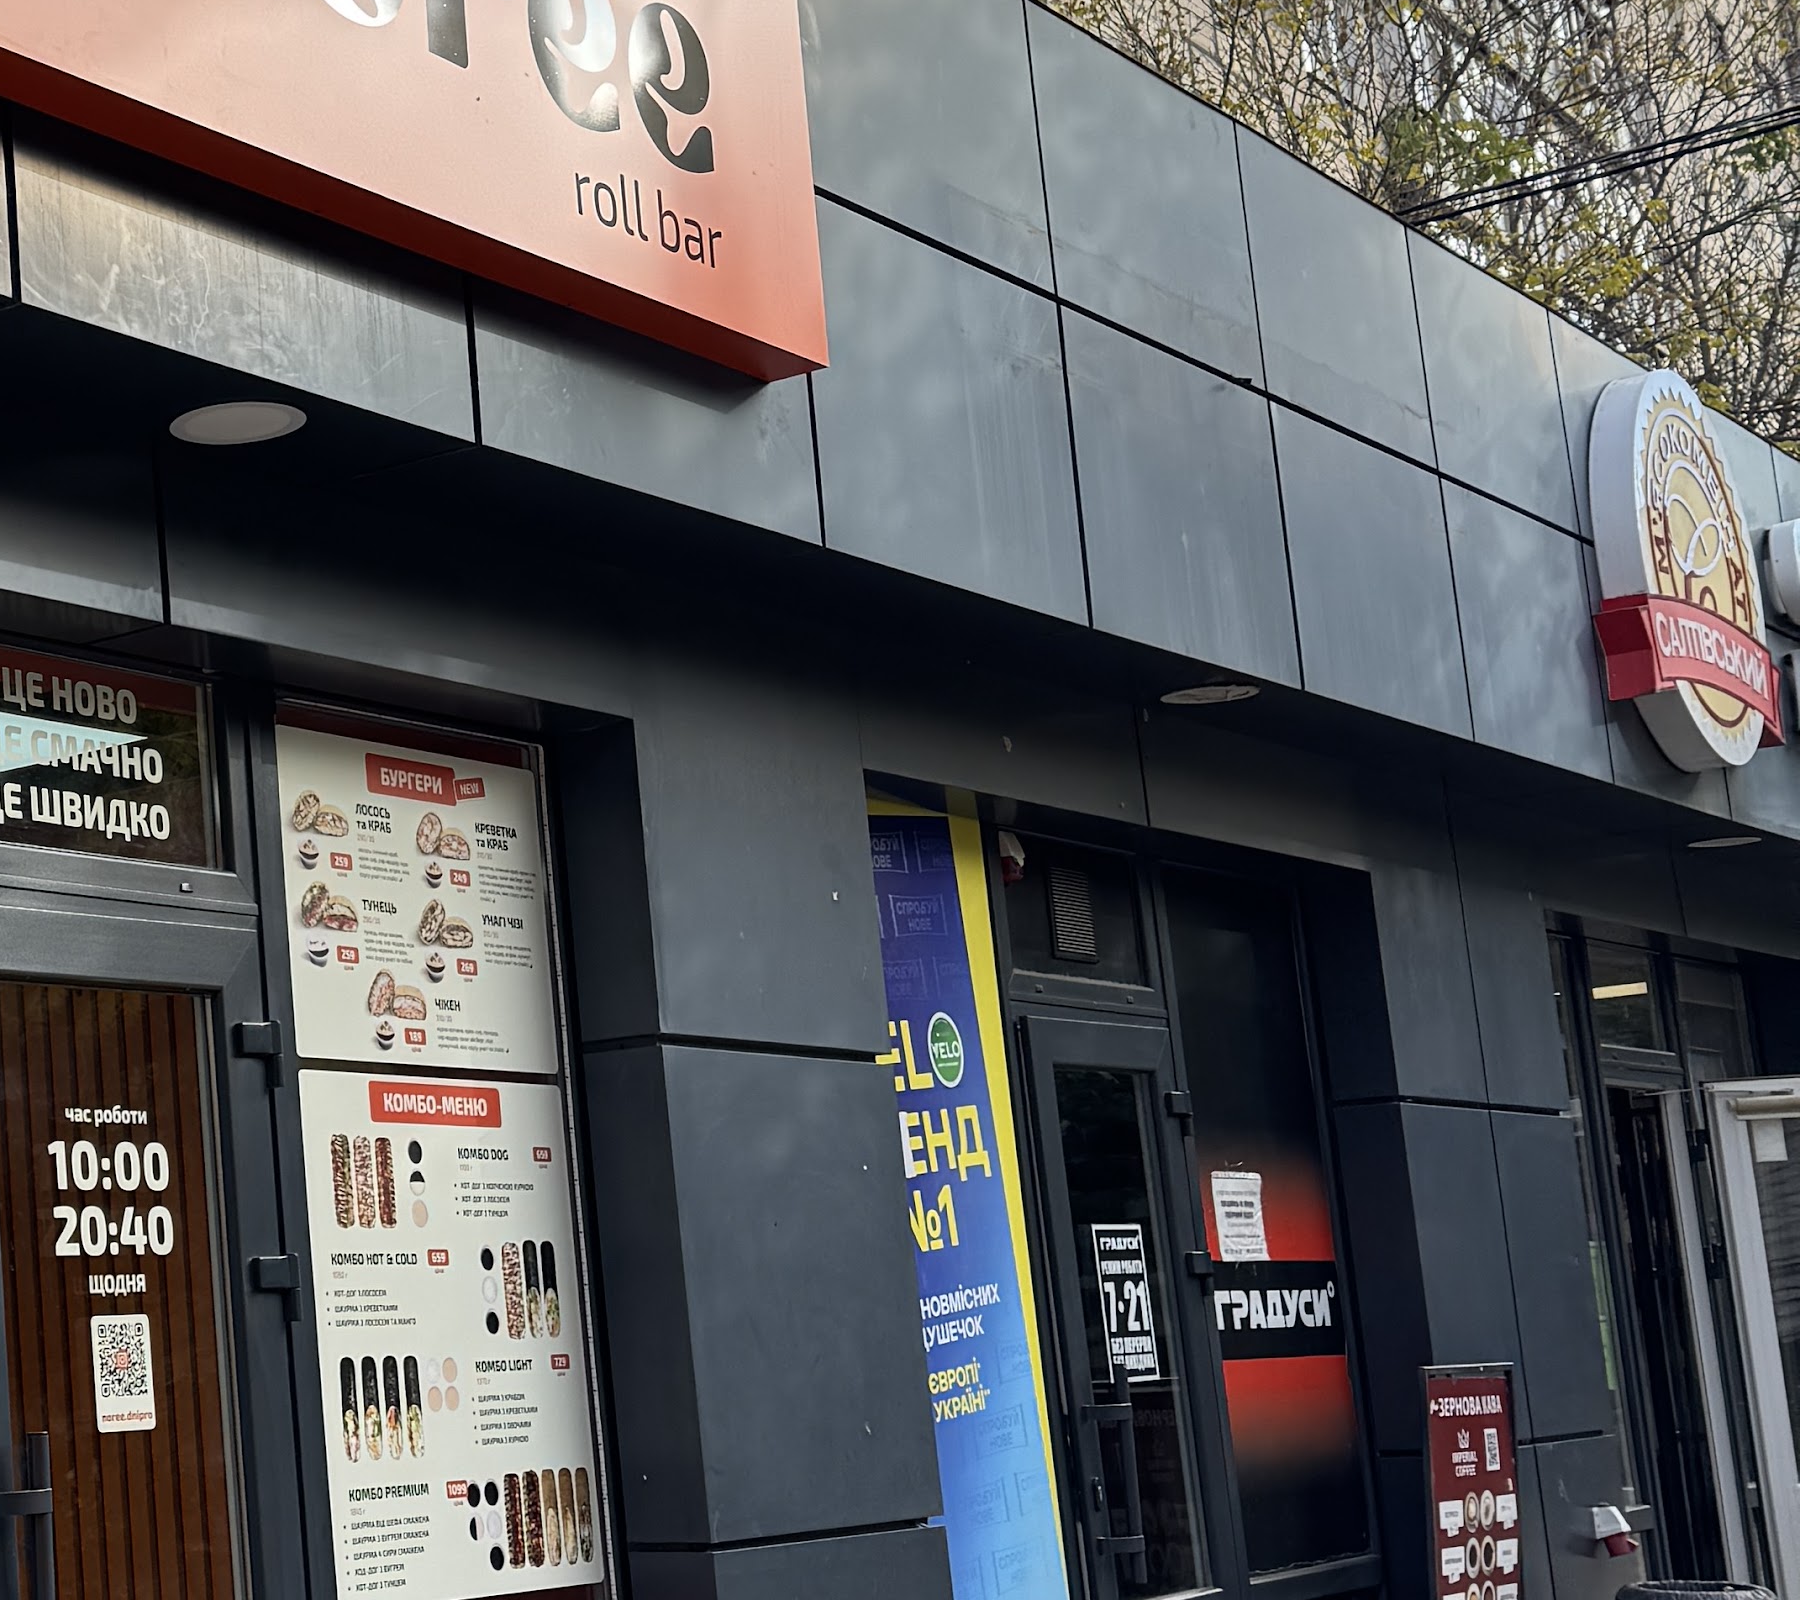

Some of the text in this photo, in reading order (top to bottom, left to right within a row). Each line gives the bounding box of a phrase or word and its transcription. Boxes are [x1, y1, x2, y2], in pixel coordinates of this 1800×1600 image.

[574, 170, 723, 269] roll bar
[1655, 612, 1769, 700] САЛТІВСЬКИЙ
[2, 667, 137, 724] ЦЕ НОВО
[30, 730, 164, 784] СМАЧНО
[381, 767, 442, 795] БУРГЕРИ
[460, 783, 479, 796] NEW
[30, 785, 170, 842] ШВИДКО
[356, 803, 390, 819] ЛОСОСЬ
[357, 820, 392, 834] та КРАБ
[475, 823, 517, 840] КРЕВЕТКА
[487, 838, 509, 851] КРАБ
[362, 899, 397, 915] ТУНЕЦЬ
[435, 998, 461, 1012] ЧІКЕН
[931, 1041, 960, 1059] VELO
[383, 1093, 487, 1117] КОМБО-МЕНЮ
[65, 1105, 147, 1127] час роботи
[458, 1148, 508, 1160] КОМБО DOG
[48, 1141, 169, 1192] 10:00
[53, 1205, 174, 1257] 20:40
[331, 1253, 417, 1265] КОМБО HOT COLD
[89, 1273, 146, 1297] щодня
[475, 1359, 532, 1373] КОМБО LIGHT
[1438, 1396, 1482, 1417] ЗЕРНОВА
[349, 1483, 467, 1502] КОМБО PREMIUM 1099
